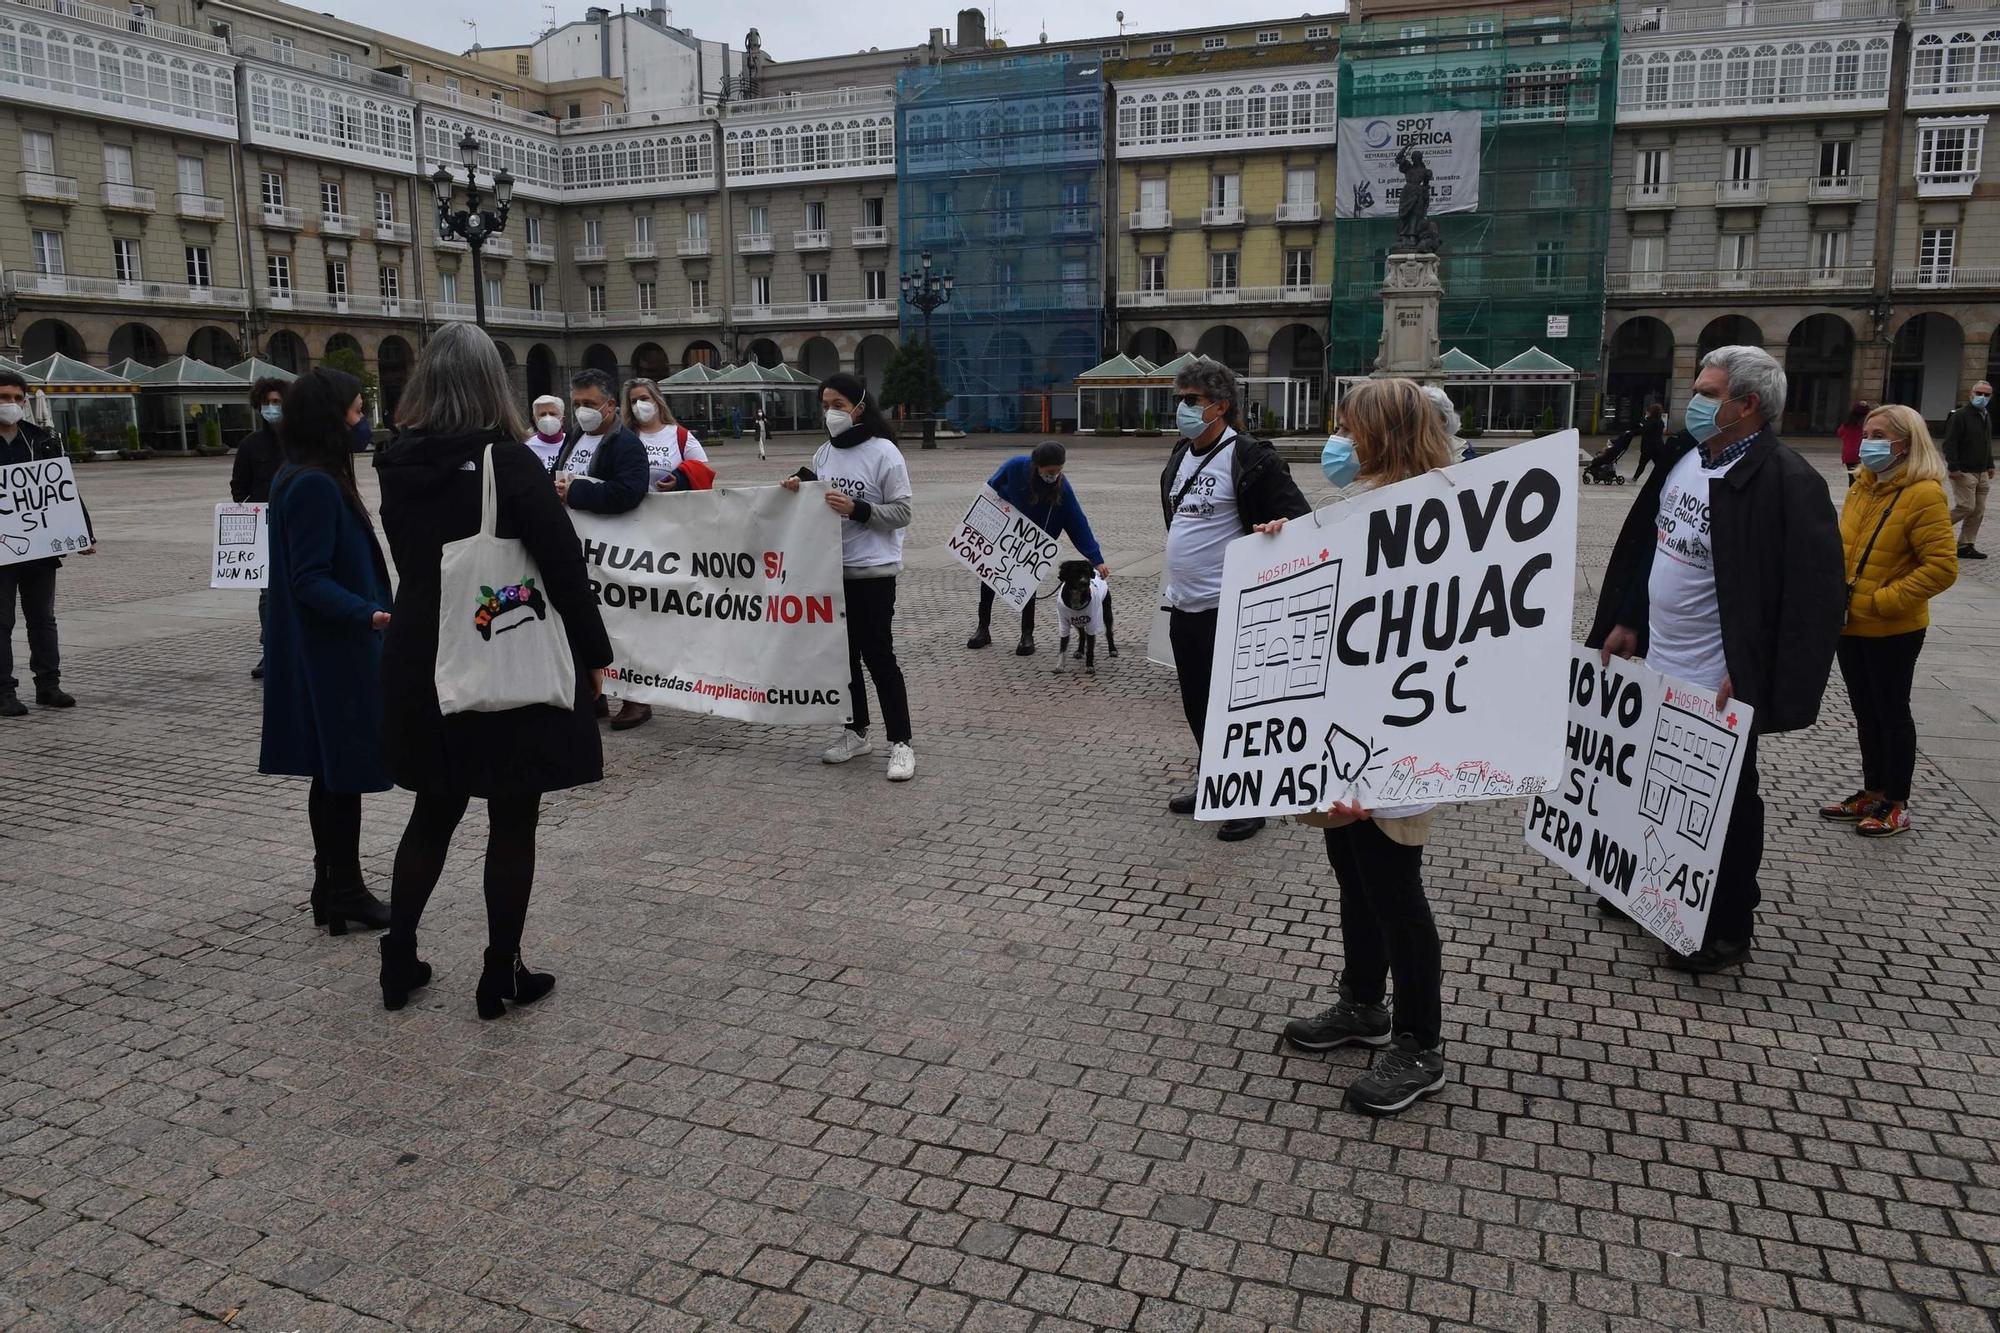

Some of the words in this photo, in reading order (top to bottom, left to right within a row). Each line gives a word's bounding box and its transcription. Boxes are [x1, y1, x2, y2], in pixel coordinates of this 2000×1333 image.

[1396, 118, 1434, 132] SPOT
[1396, 131, 1453, 147] IBÉRICA
[1204, 487, 1214, 496] SI
[21, 507, 48, 532] SÍ
[1366, 467, 1561, 577] NOVO
[1674, 507, 1699, 528] CHUAC
[217, 550, 255, 566] PERO
[584, 538, 681, 575] HUAC
[690, 552, 756, 579] NOVO
[948, 537, 982, 565] NON
[961, 526, 994, 556] PERO
[999, 534, 1052, 582] CHUAC
[1013, 517, 1058, 560] NOVO
[216, 567, 241, 580] NON
[244, 564, 265, 580] ASÍ
[1257, 555, 1314, 583] HOSPITAL
[587, 579, 762, 622] ROPIACIÓNS
[765, 595, 834, 624] NON
[1337, 553, 1552, 667] CHUAC
[1383, 655, 1468, 728] SÍ
[1673, 691, 1722, 724] HOSPITAL
[1223, 717, 1308, 760] PERO
[1565, 720, 1637, 788] HUAC
[1200, 770, 1263, 810] NON
[1270, 750, 1328, 807] ASÍ
[1564, 768, 1600, 817] SÍ
[1528, 795, 1584, 859] PERO
[1586, 828, 1638, 897] NON
[1665, 863, 1715, 912] ASÍ
